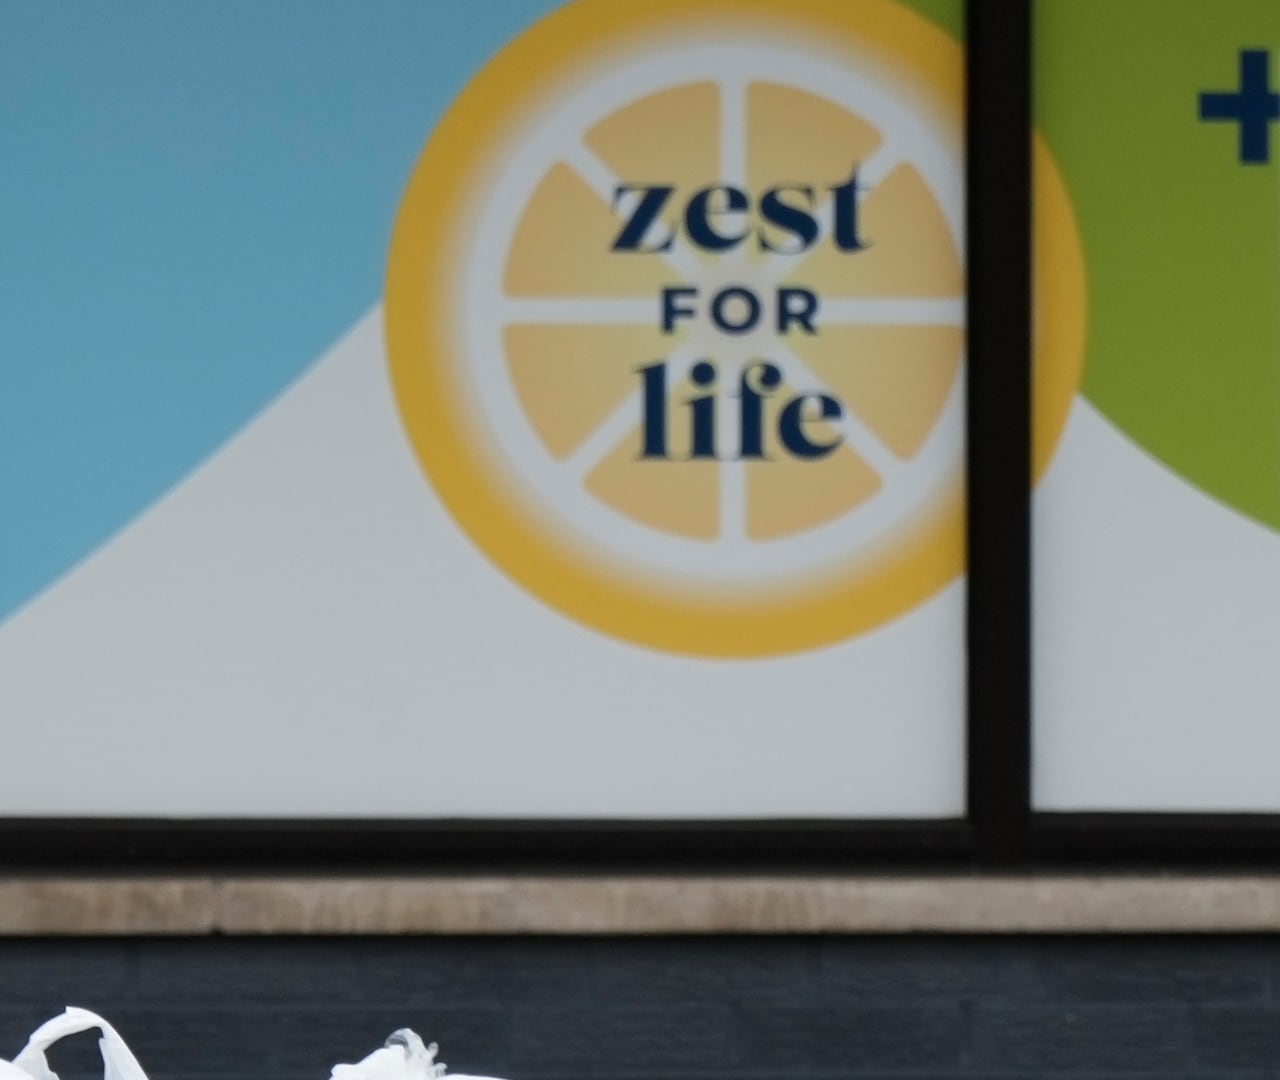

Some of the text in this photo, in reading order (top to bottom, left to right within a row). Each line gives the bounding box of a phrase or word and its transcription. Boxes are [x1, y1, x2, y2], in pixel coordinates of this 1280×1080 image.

[609, 162, 873, 255] zest
[660, 286, 820, 336] FOR
[636, 360, 845, 463] life
